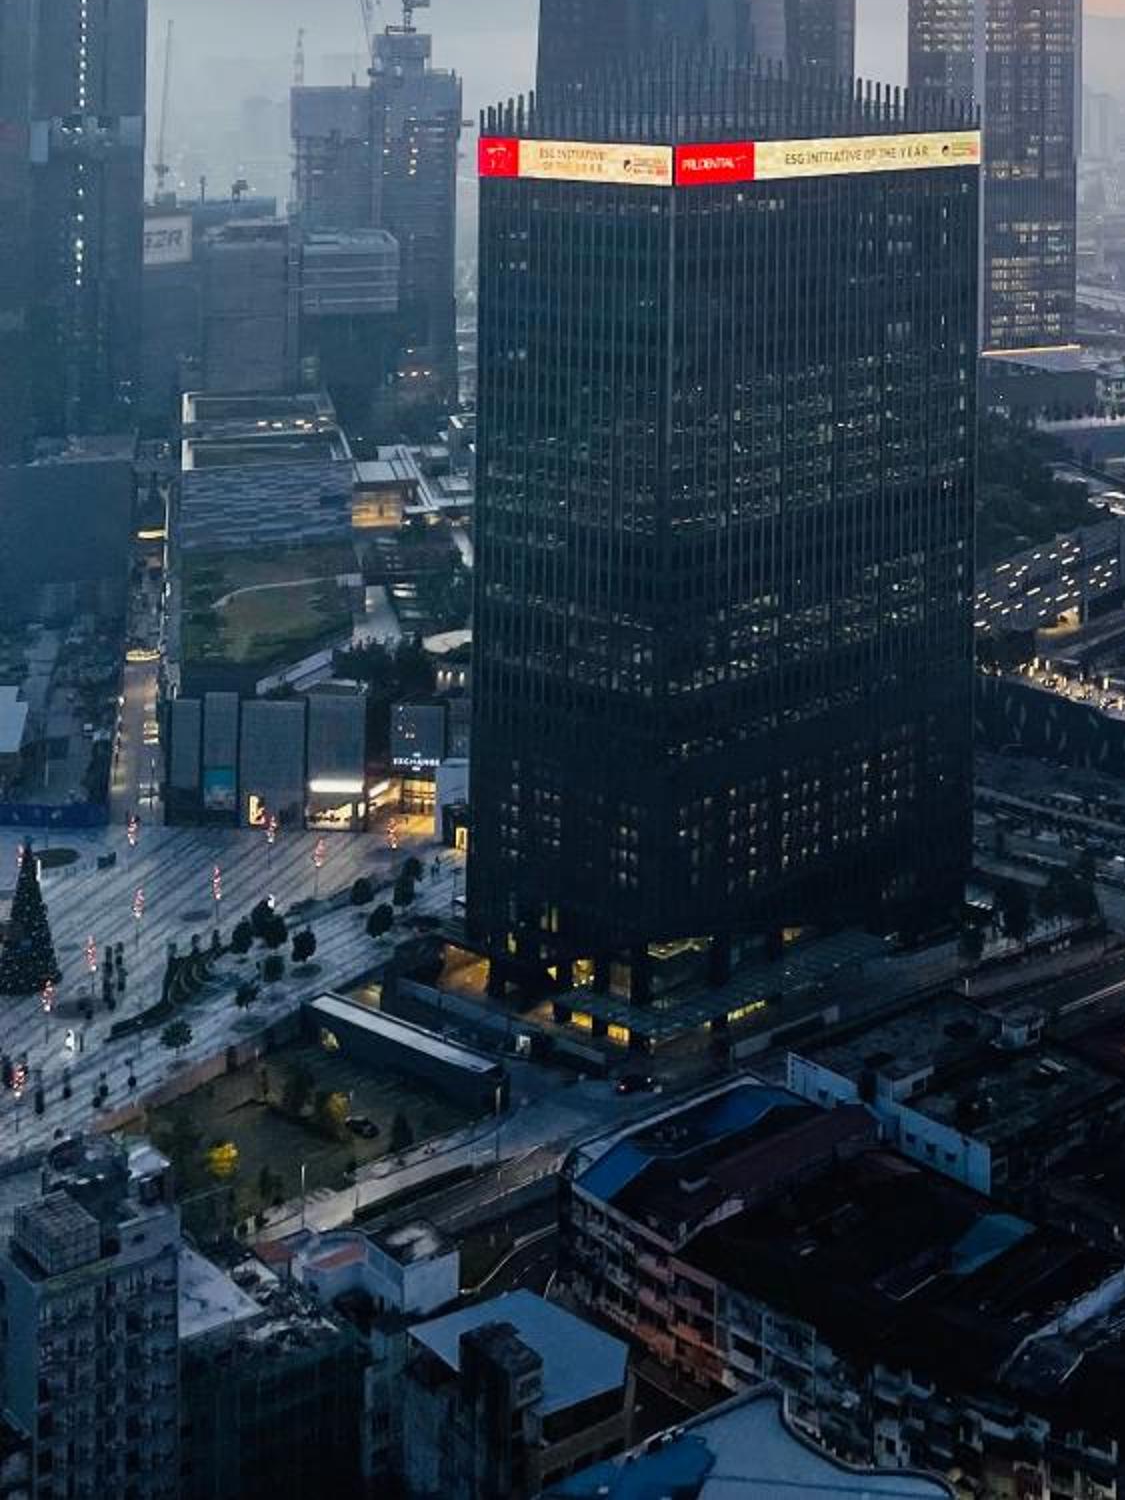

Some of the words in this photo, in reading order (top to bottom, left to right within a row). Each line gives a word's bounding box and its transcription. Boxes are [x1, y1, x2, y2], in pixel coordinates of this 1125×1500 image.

[681, 156, 736, 171] PRUDENTIAL
[785, 152, 804, 165] ESG
[807, 149, 861, 163] INITIATIVE
[864, 148, 876, 159] OF
[879, 147, 897, 159] THE
[900, 145, 928, 158] YEAR
